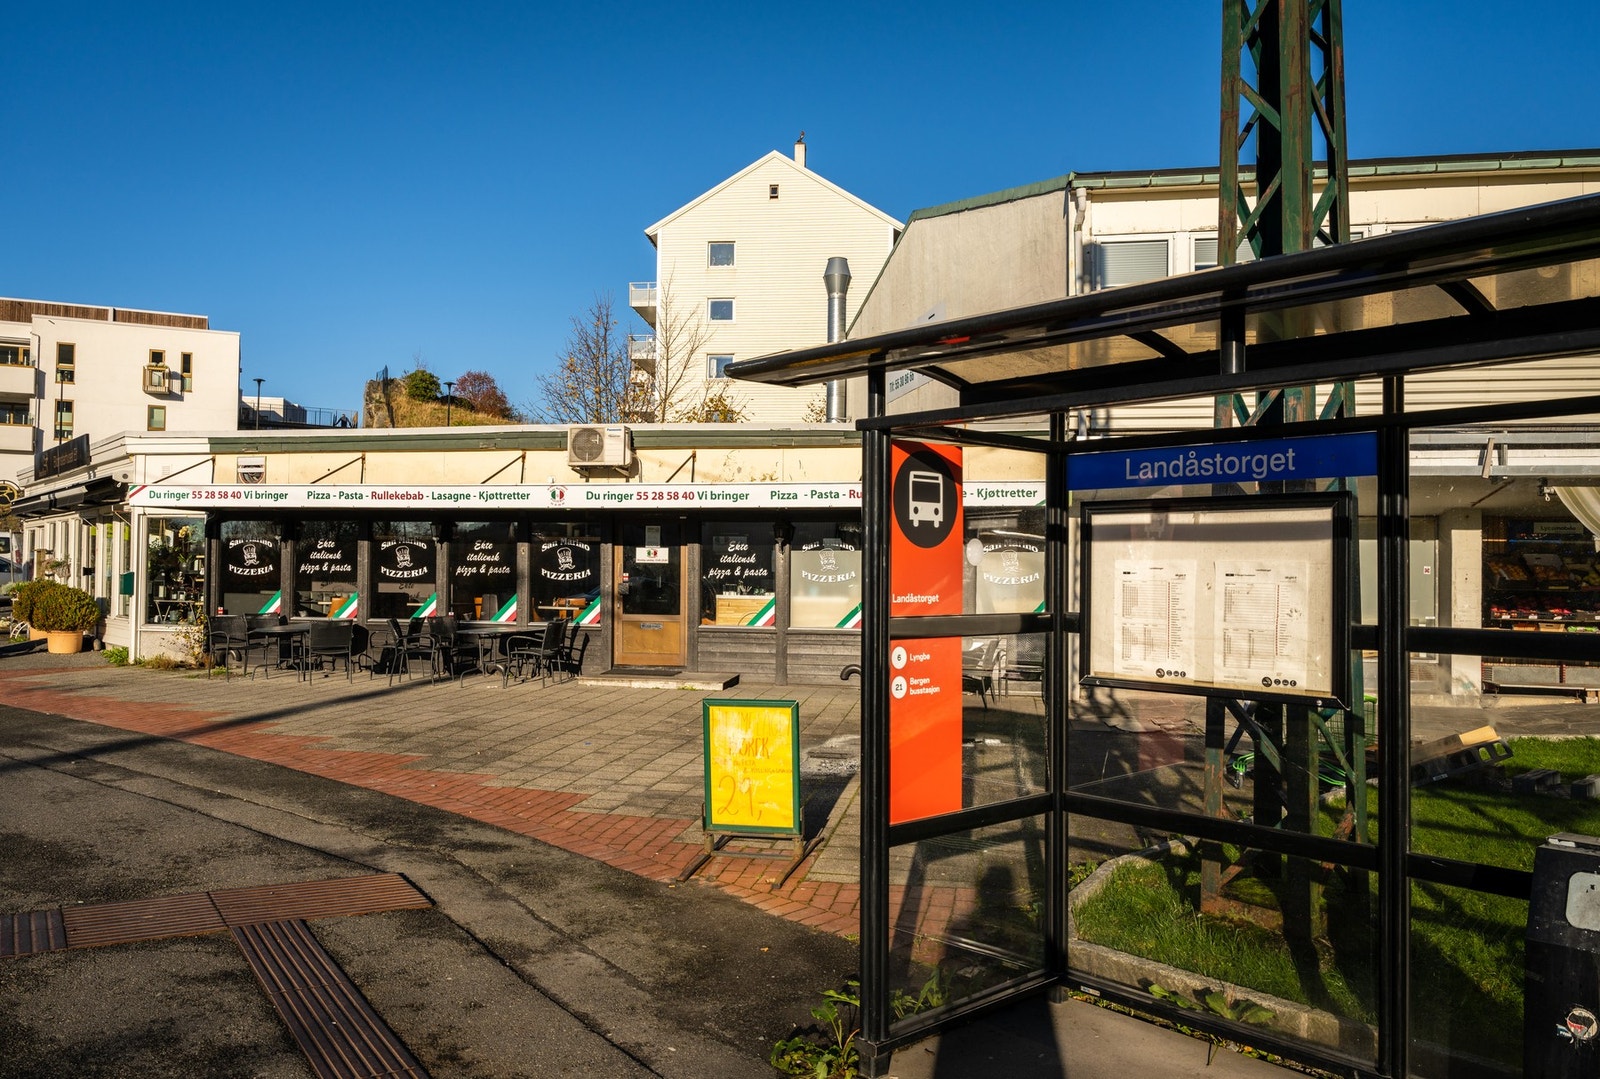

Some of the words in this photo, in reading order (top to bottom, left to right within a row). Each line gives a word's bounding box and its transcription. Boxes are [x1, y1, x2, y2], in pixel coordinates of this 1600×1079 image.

[1125, 448, 1296, 480] Landåstorget
[149, 490, 162, 499] Du
[163, 490, 190, 502] ringer
[192, 490, 203, 499] 55
[204, 490, 216, 499] 28
[217, 490, 229, 499] 58
[230, 490, 242, 499] 40
[243, 490, 253, 499] Vi
[254, 490, 289, 502] bringer
[306, 490, 331, 500] Pizza
[338, 490, 364, 500] Pasta
[370, 490, 424, 500] Rullekebab
[431, 491, 471, 502] Lasagne
[478, 490, 531, 503] Kjøttretter
[586, 490, 601, 500] Du
[603, 490, 634, 503] ringer
[636, 491, 649, 500] 55
[651, 491, 665, 500] 28
[666, 491, 680, 500] 58
[681, 491, 695, 500] 40
[697, 490, 708, 500] Vi
[710, 490, 750, 503] bringer
[770, 490, 798, 500] Pizza
[810, 489, 840, 499] Pasta
[976, 488, 1038, 500] Kjøttretter
[316, 538, 336, 549] Ekte
[380, 538, 397, 551] San
[473, 539, 493, 550] Ekte
[541, 539, 560, 552] San
[560, 537, 590, 551] Marino
[727, 540, 749, 552] Ekte
[983, 542, 1001, 555] San
[309, 550, 342, 560] italiensk
[466, 551, 500, 562] italiensk
[719, 553, 757, 564] italiensk
[228, 563, 274, 576] PIZZERIA
[299, 563, 320, 574] pizza
[322, 562, 329, 571] &
[330, 562, 352, 574] pasta
[380, 565, 428, 578] PIZZERIA
[455, 565, 477, 577] pizza
[479, 564, 486, 573] &
[488, 564, 511, 576] pasta
[541, 567, 591, 581] PIZZERIA
[708, 566, 731, 579] pizza
[733, 565, 741, 576] &
[744, 566, 768, 578] pasta
[801, 570, 856, 583] PIZZERIA
[983, 572, 1040, 585] PIZZERIA
[892, 593, 940, 605] Landåstorget
[896, 654, 902, 662] 6
[909, 677, 931, 687] Bergen
[895, 683, 903, 692] 21
[909, 685, 941, 696] busstasjon
